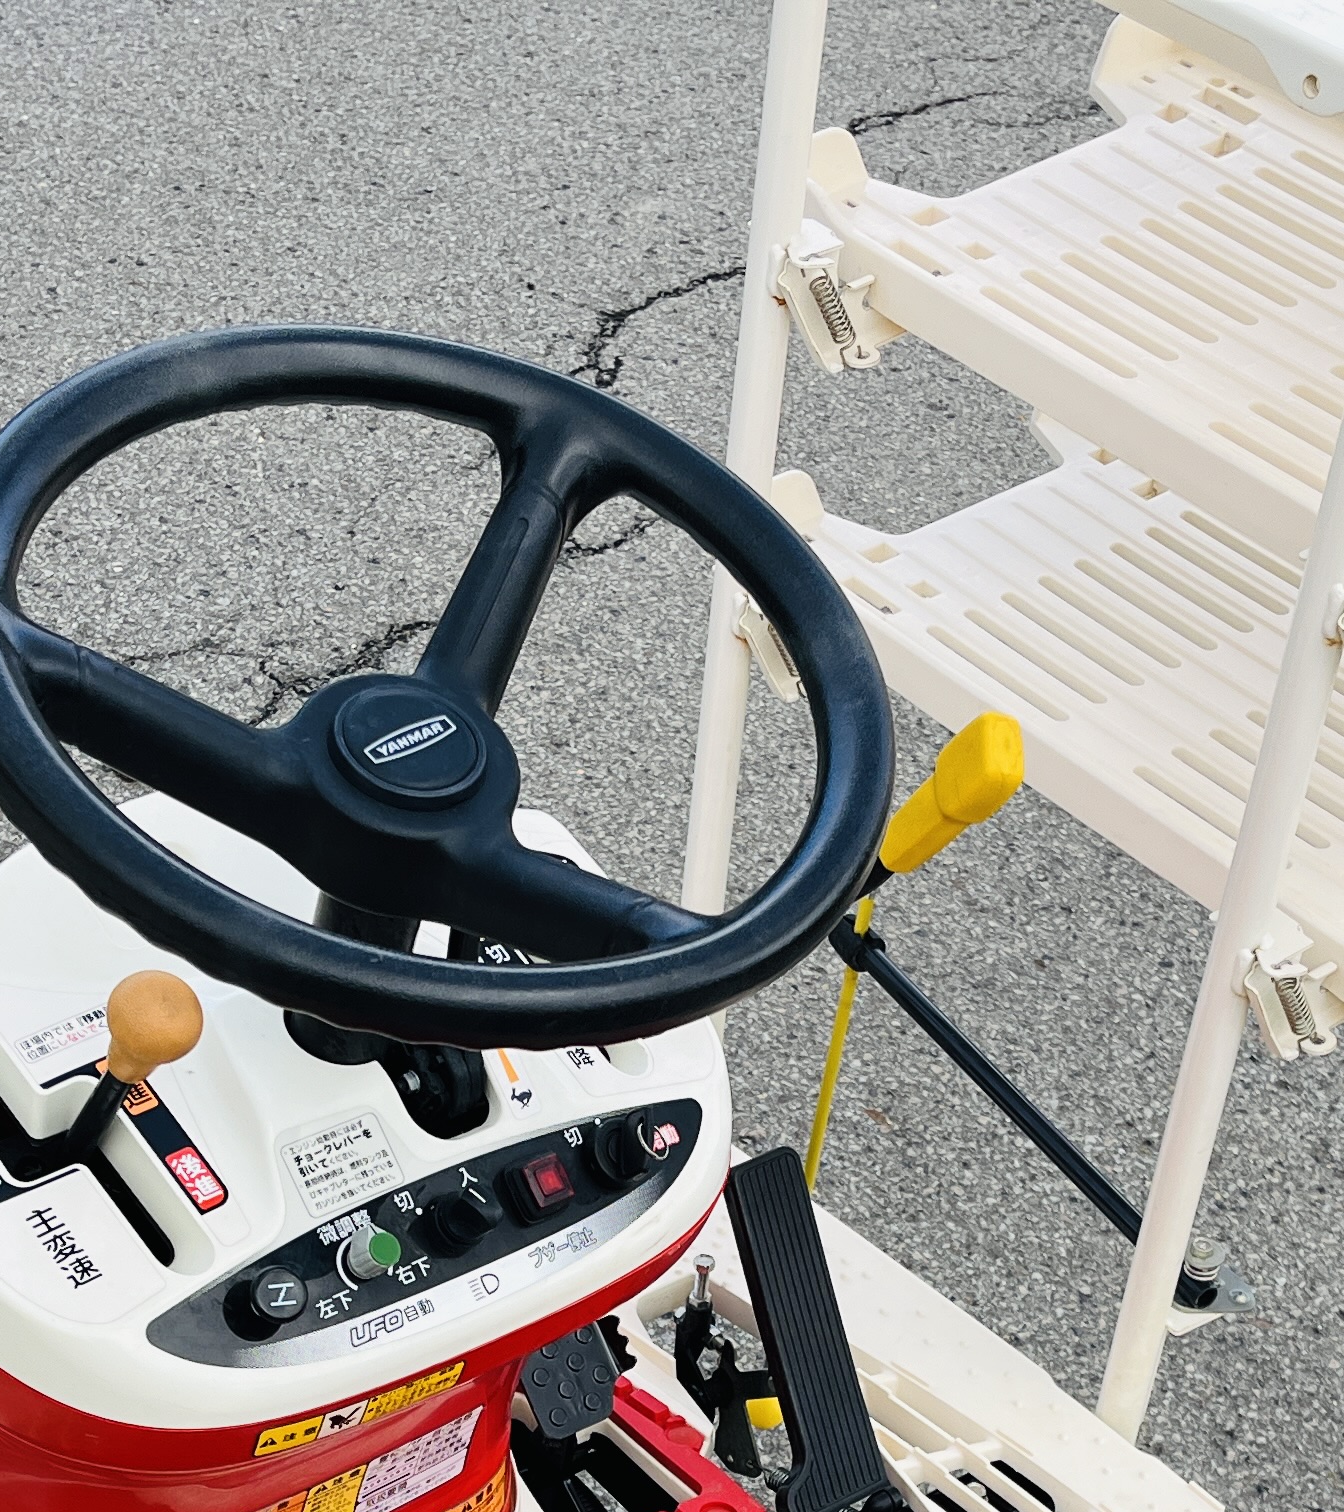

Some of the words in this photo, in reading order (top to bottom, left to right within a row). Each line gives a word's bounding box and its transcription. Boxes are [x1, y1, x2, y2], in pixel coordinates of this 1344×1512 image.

[375, 721, 444, 757] YANMAR
[484, 943, 511, 964] 切
[293, 1128, 373, 1167] チョークレバーを
[563, 1126, 583, 1148] 切
[168, 1152, 225, 1204] 後進
[393, 1190, 416, 1213] 切
[316, 1208, 372, 1246] 微調整
[25, 1207, 103, 1290] 主変速
[528, 1227, 598, 1269] ブザー停止
[394, 1255, 432, 1286] 右下
[315, 1289, 353, 1320] 左下
